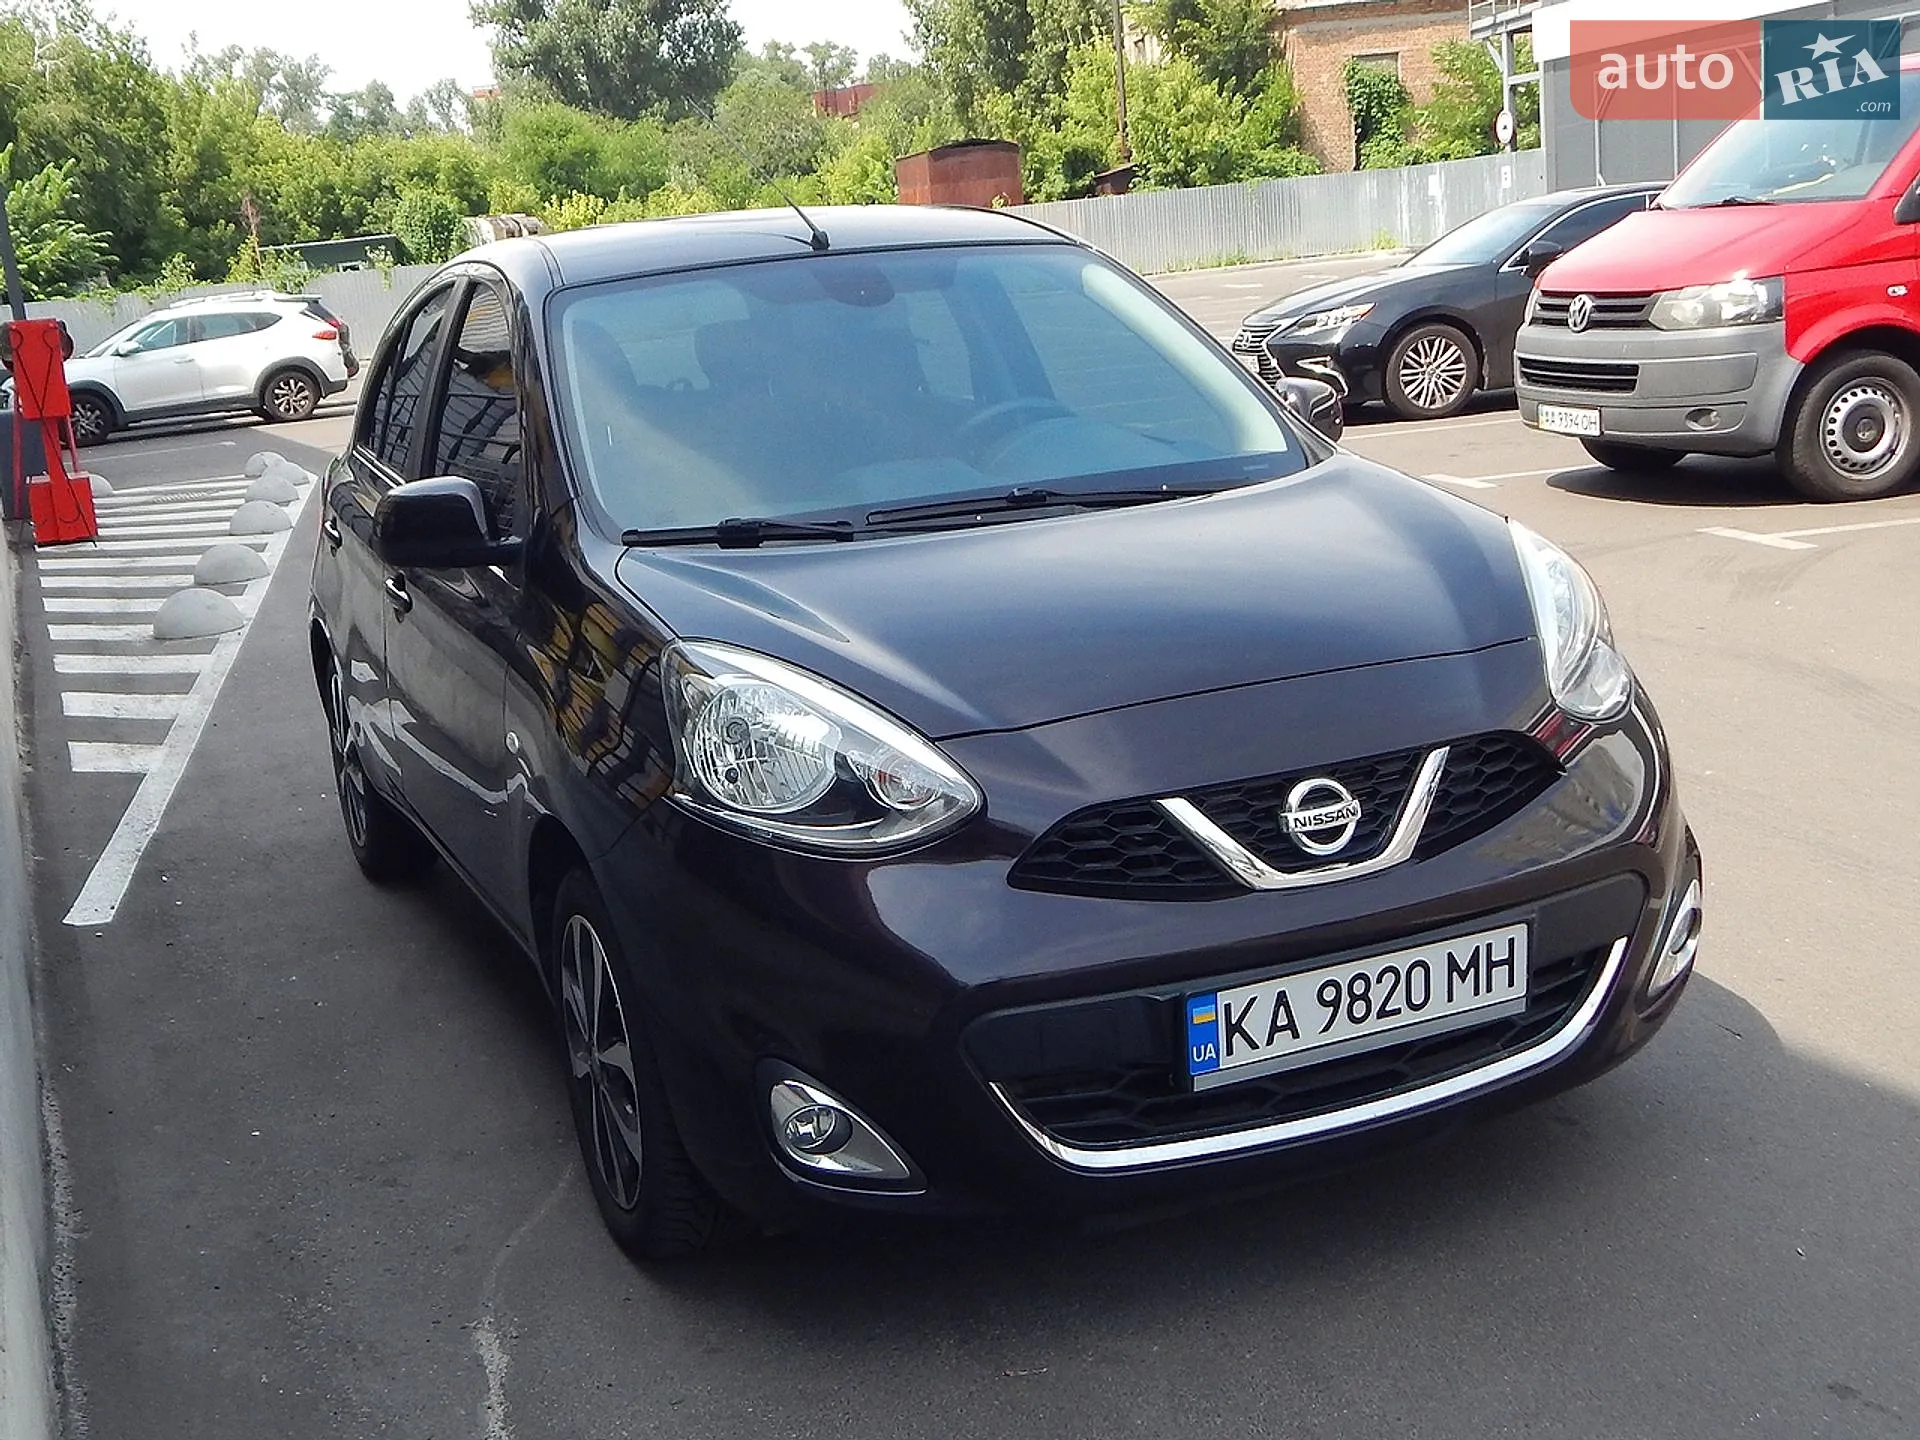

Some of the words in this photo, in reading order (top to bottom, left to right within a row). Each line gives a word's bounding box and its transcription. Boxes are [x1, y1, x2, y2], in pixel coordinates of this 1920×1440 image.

[1294, 807, 1356, 828] NISSAN
[1223, 989, 1300, 1057] KA
[1316, 959, 1431, 1034] 9820
[1447, 937, 1515, 1003] MH
[1193, 1043, 1216, 1062] UA
